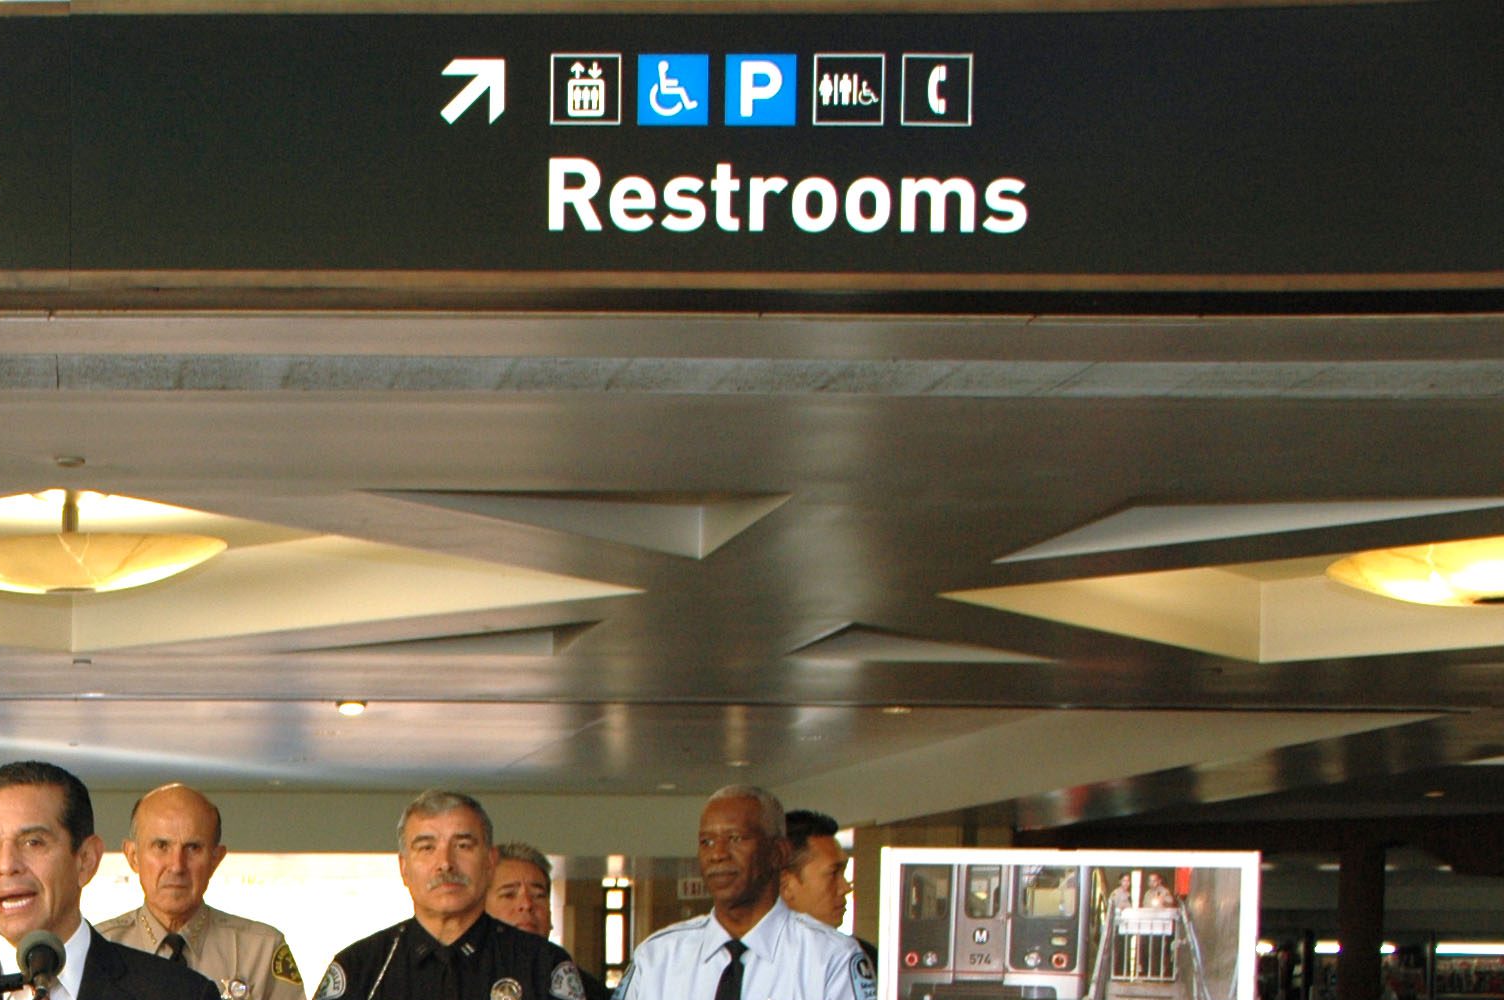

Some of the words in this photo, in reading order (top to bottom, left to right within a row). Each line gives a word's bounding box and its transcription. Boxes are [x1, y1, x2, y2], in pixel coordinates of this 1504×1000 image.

[740, 61, 782, 117] P
[548, 157, 1028, 232] Restrooms
[969, 953, 991, 965] 574
